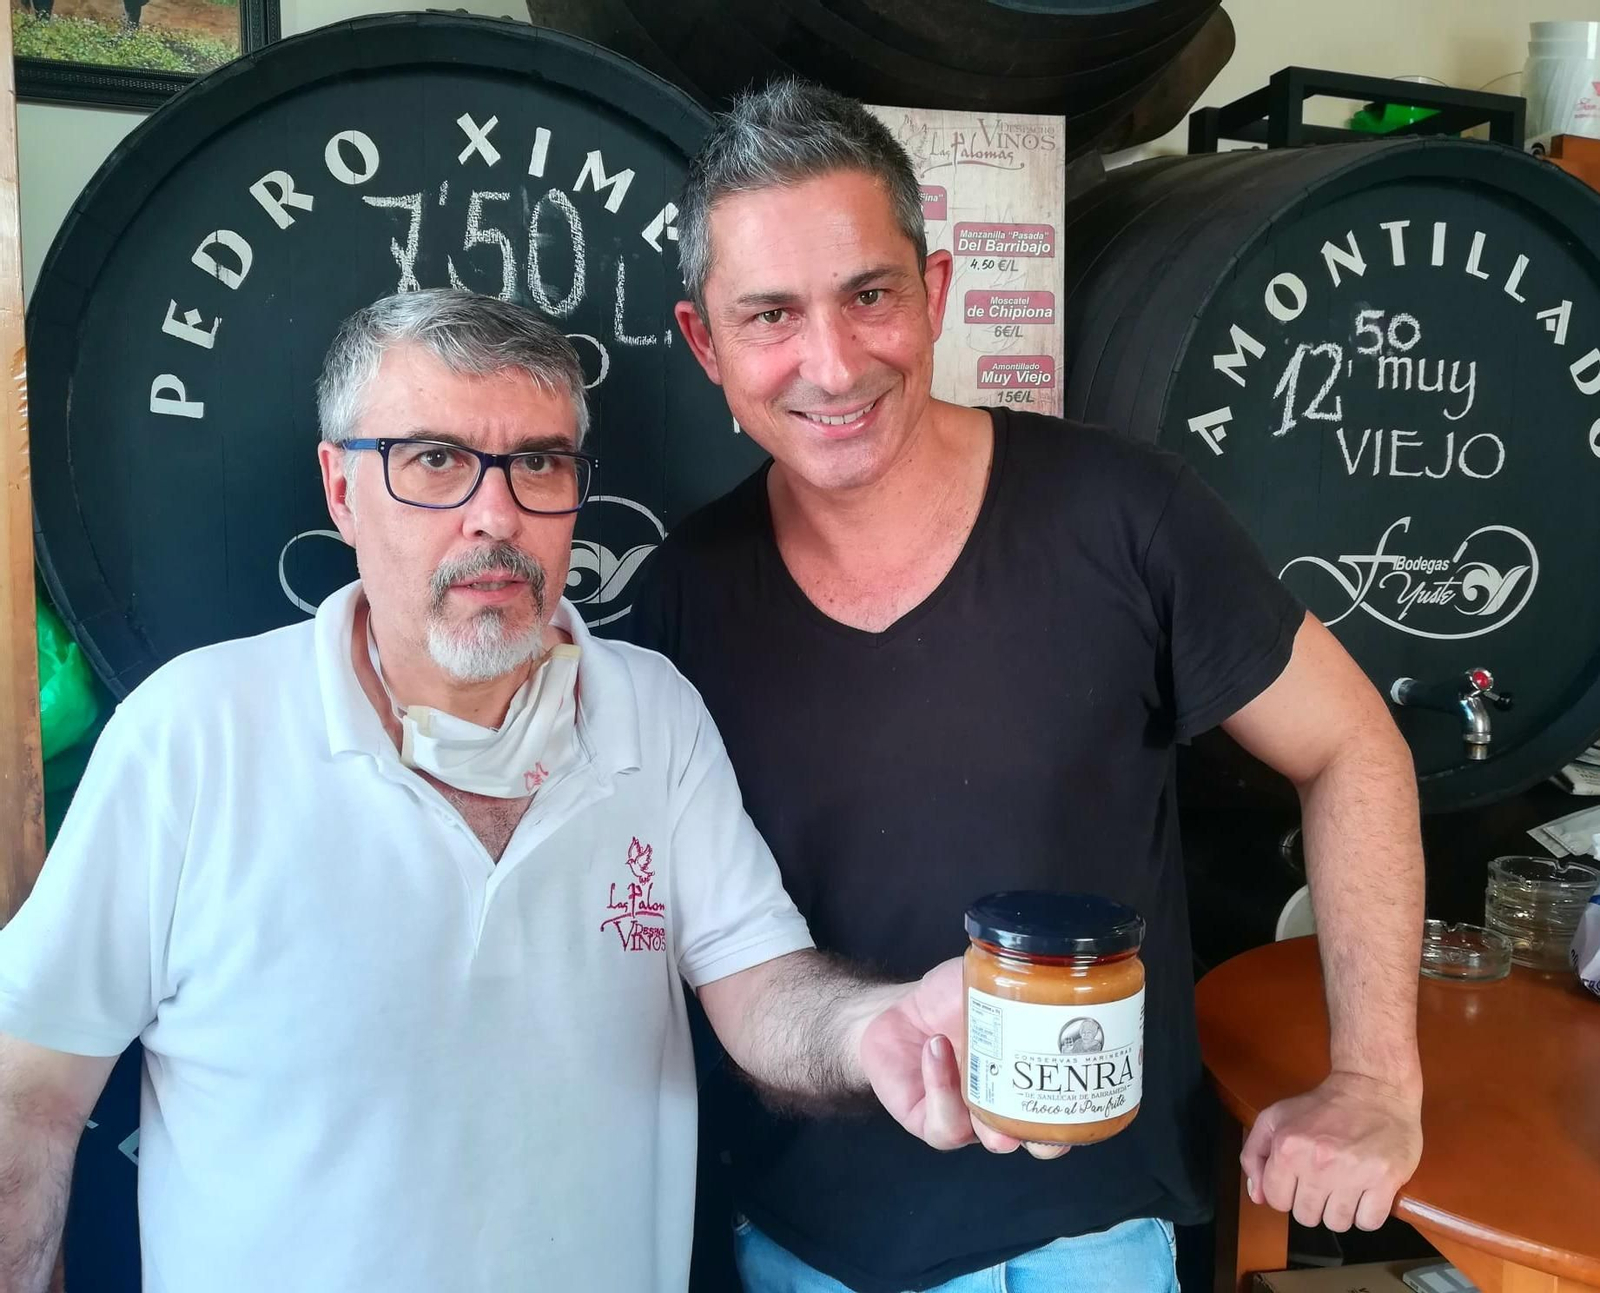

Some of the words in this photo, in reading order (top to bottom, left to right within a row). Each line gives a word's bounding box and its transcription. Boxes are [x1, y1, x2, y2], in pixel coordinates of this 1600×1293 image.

[977, 118, 1056, 150] VINOS
[929, 131, 951, 158] Las
[951, 131, 1014, 167] Palomas
[958, 238, 981, 251] Del
[985, 239, 1051, 256] Barribajo
[960, 230, 1006, 240] Manzanilla
[1008, 231, 1050, 240] "Pasada"
[150, 129, 380, 420] PEDRO
[456, 112, 681, 253] XIME
[990, 296, 1030, 305] Moscatel
[967, 305, 985, 318] de
[989, 305, 1053, 321] Chipiona
[994, 325, 1024, 338] 6€/L
[1188, 219, 1600, 457] AMONTILLAD
[1354, 309, 1422, 352] 50
[981, 370, 1012, 386] Muy
[1016, 370, 1052, 386] Viejo
[991, 363, 1040, 371] Amontillado
[998, 390, 1035, 403] 15€/L
[1377, 354, 1477, 421] muy
[1336, 427, 1506, 480] VIEJO
[1394, 555, 1451, 575] Bodegas
[1379, 571, 1463, 621] Yuste
[606, 882, 629, 912] Las
[1014, 1053, 1078, 1064] CONSERVAS
[1085, 1047, 1132, 1062] MARINERAS
[1012, 1055, 1134, 1094] SENRA
[1022, 1099, 1063, 1115] Choco
[1064, 1101, 1078, 1115] al
[1079, 1099, 1105, 1114] Pan
[1104, 1094, 1125, 1118] frito
